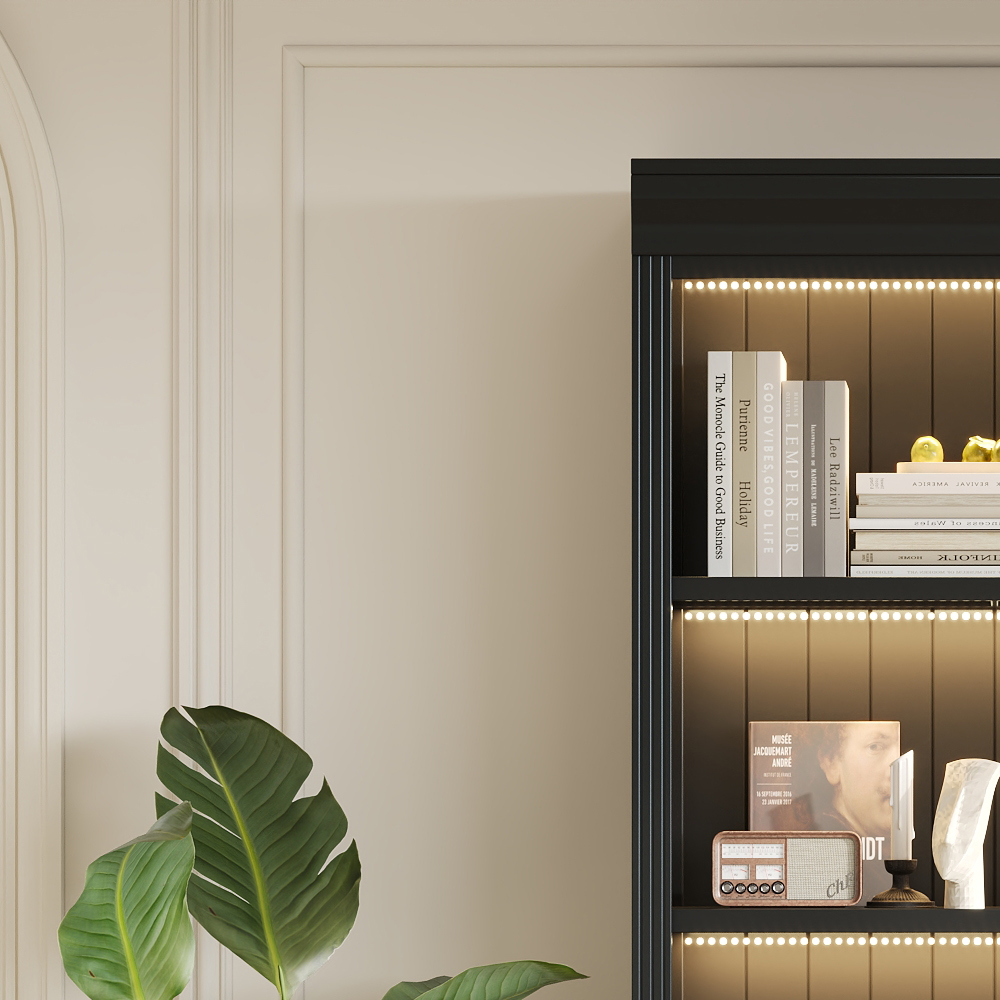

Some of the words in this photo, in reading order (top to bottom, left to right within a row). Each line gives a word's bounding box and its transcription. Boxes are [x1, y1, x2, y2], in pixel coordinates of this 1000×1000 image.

[715, 373, 726, 394] The
[715, 396, 726, 439] Monocle
[763, 382, 774, 424] GOOD
[739, 399, 751, 452] Purienne
[715, 442, 726, 472] Guide
[829, 437, 840, 458] Lee
[715, 475, 725, 485] to
[829, 463, 841, 520] Radziwill
[715, 487, 726, 515] Good
[736, 481, 751, 528] Holiday
[715, 518, 726, 560] Business
[763, 523, 774, 554] LIFE
[753, 746, 792, 756] JACQUEMART
[771, 734, 792, 745] MUSÉE
[772, 757, 792, 767] ANDRÉ
